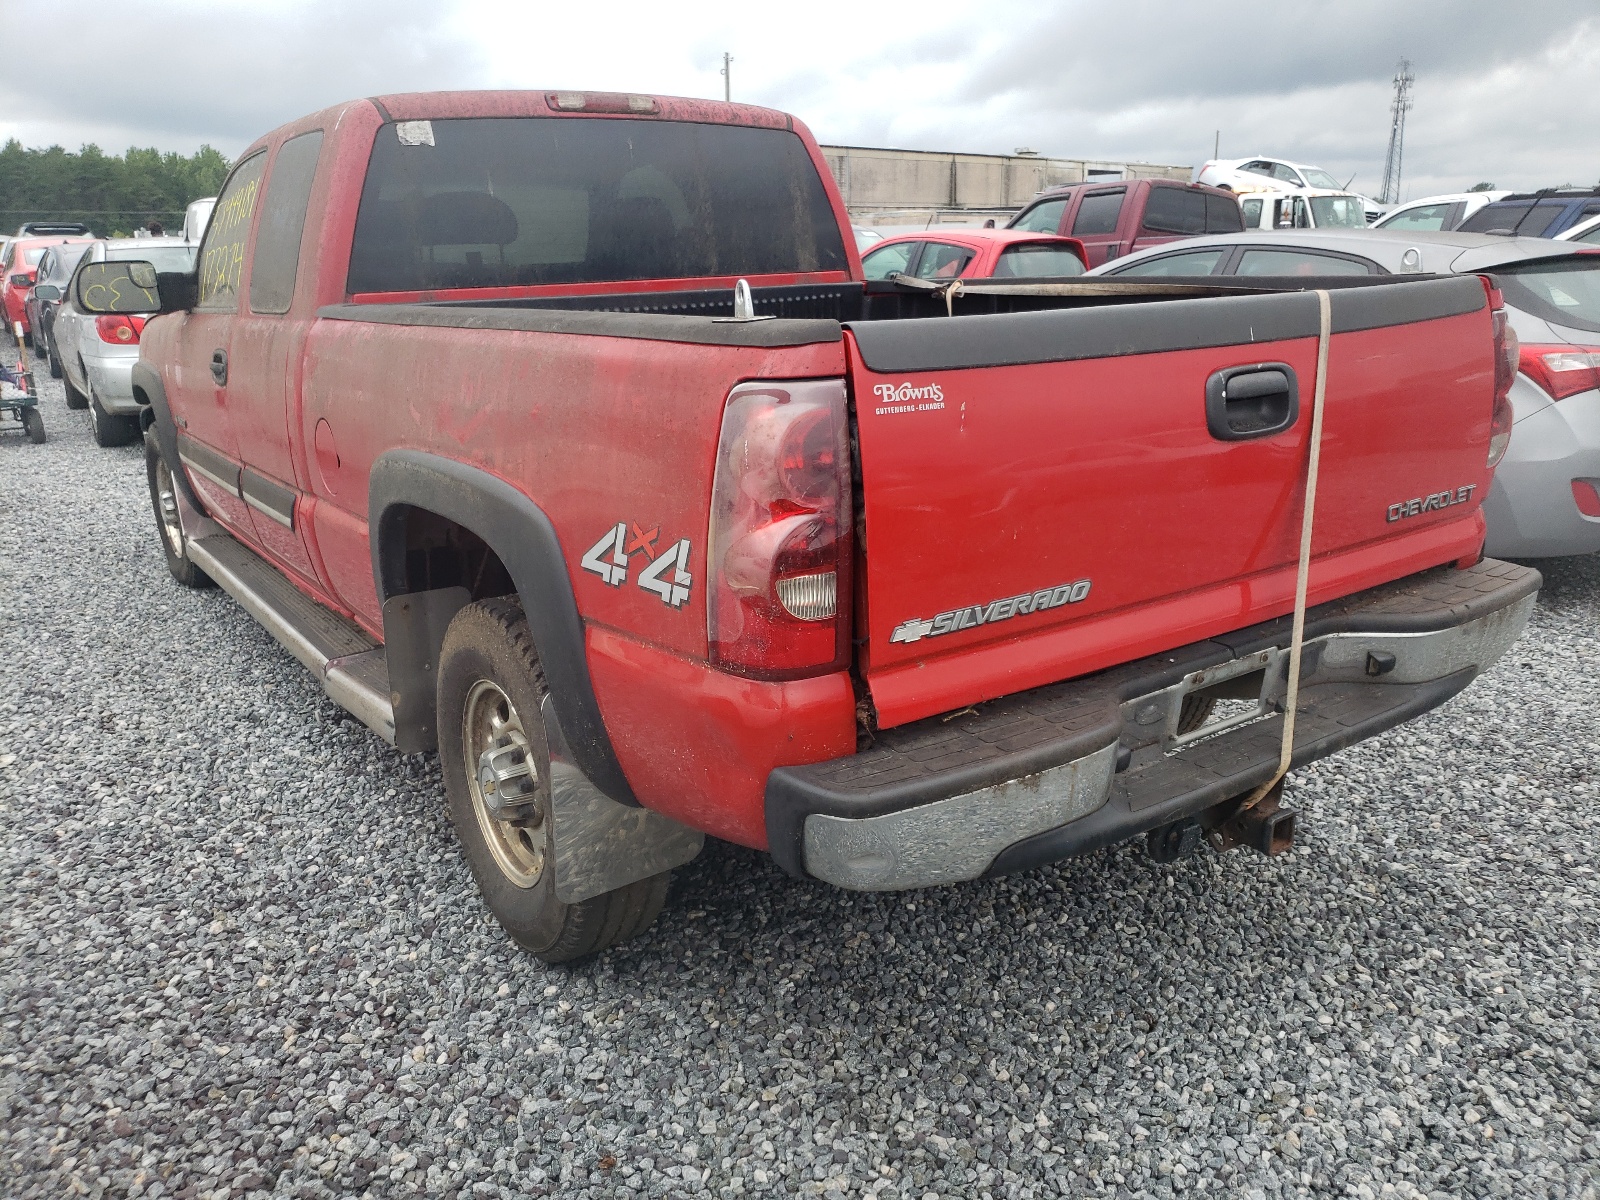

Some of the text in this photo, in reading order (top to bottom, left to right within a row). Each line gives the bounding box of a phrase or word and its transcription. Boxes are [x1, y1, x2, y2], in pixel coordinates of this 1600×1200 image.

[873, 382, 944, 402] Brown's
[1387, 484, 1477, 522] CHEVROLET
[929, 579, 1092, 637] SILVERADO
